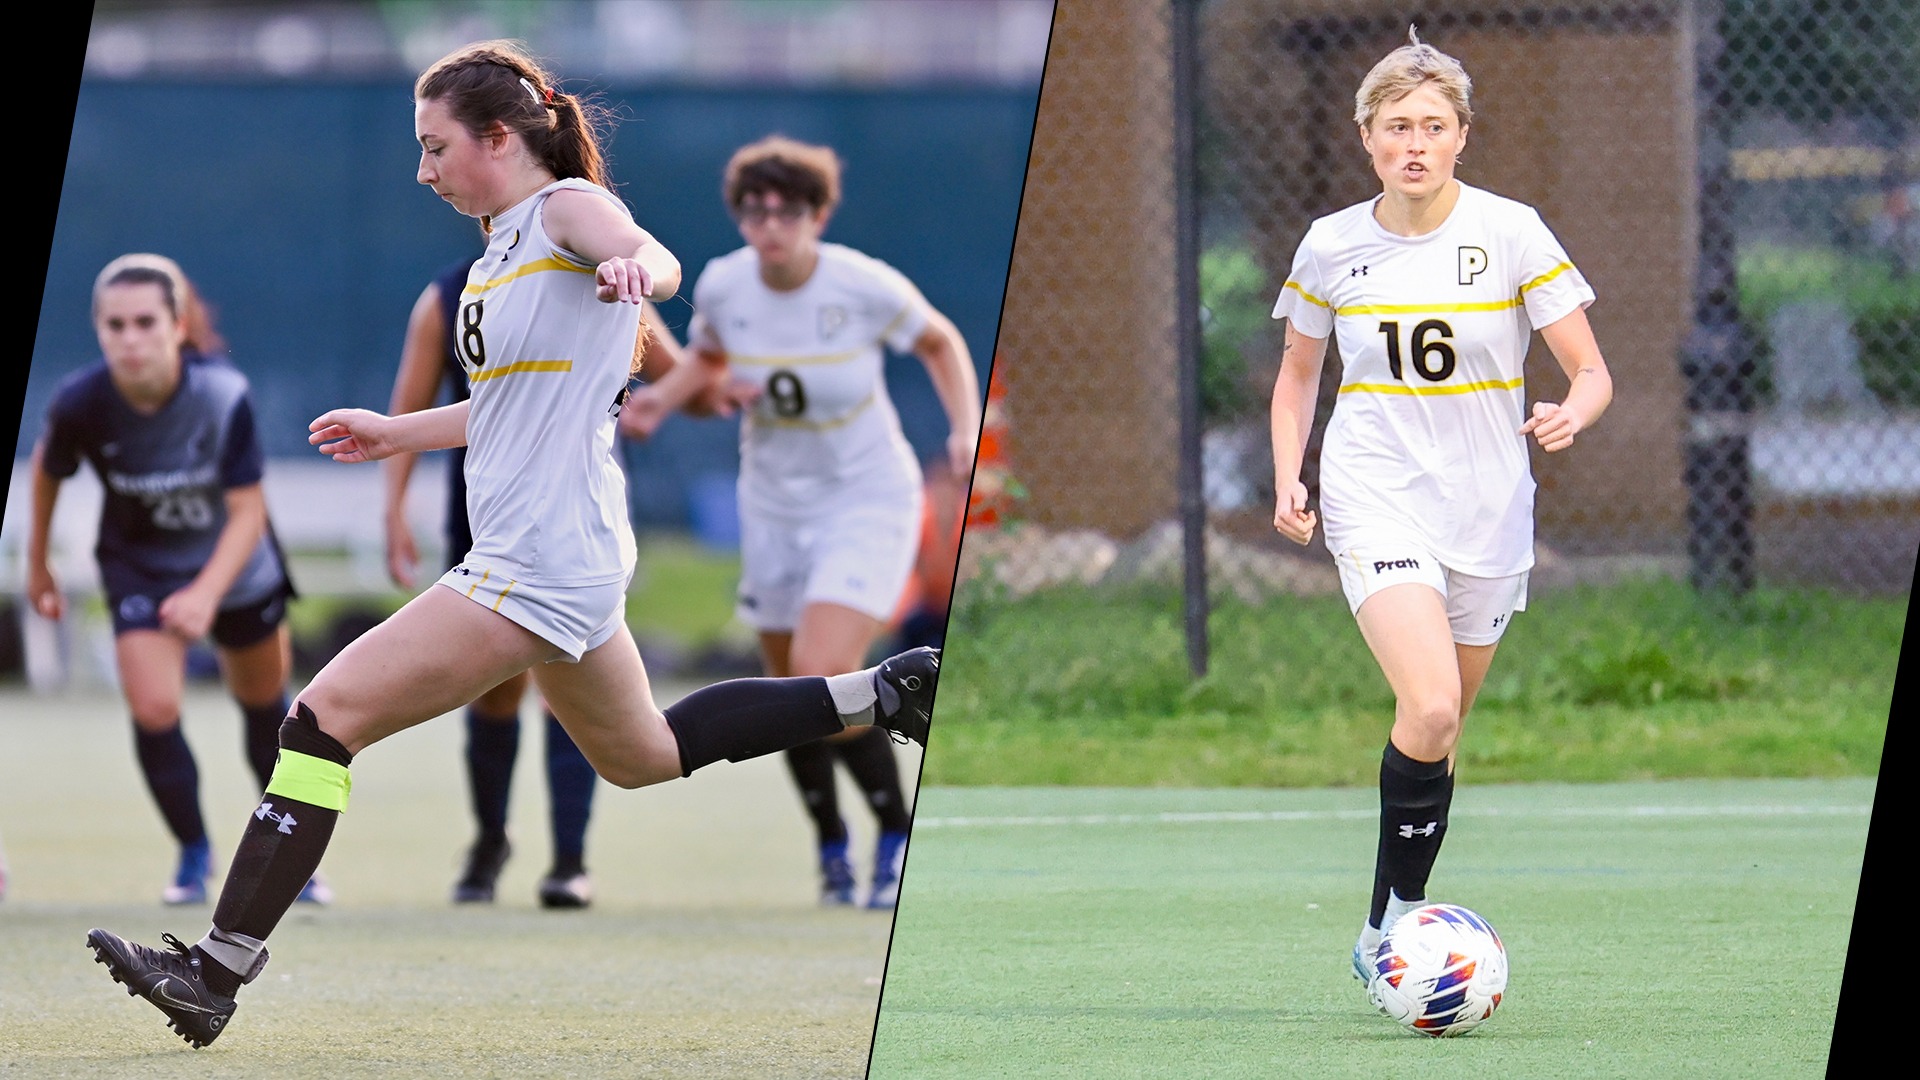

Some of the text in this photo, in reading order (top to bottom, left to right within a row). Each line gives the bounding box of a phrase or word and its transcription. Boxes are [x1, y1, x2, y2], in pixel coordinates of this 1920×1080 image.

[1458, 245, 1488, 285] P
[1378, 318, 1456, 382] 16
[767, 369, 807, 418] 9
[1373, 557, 1420, 575] Pratt
